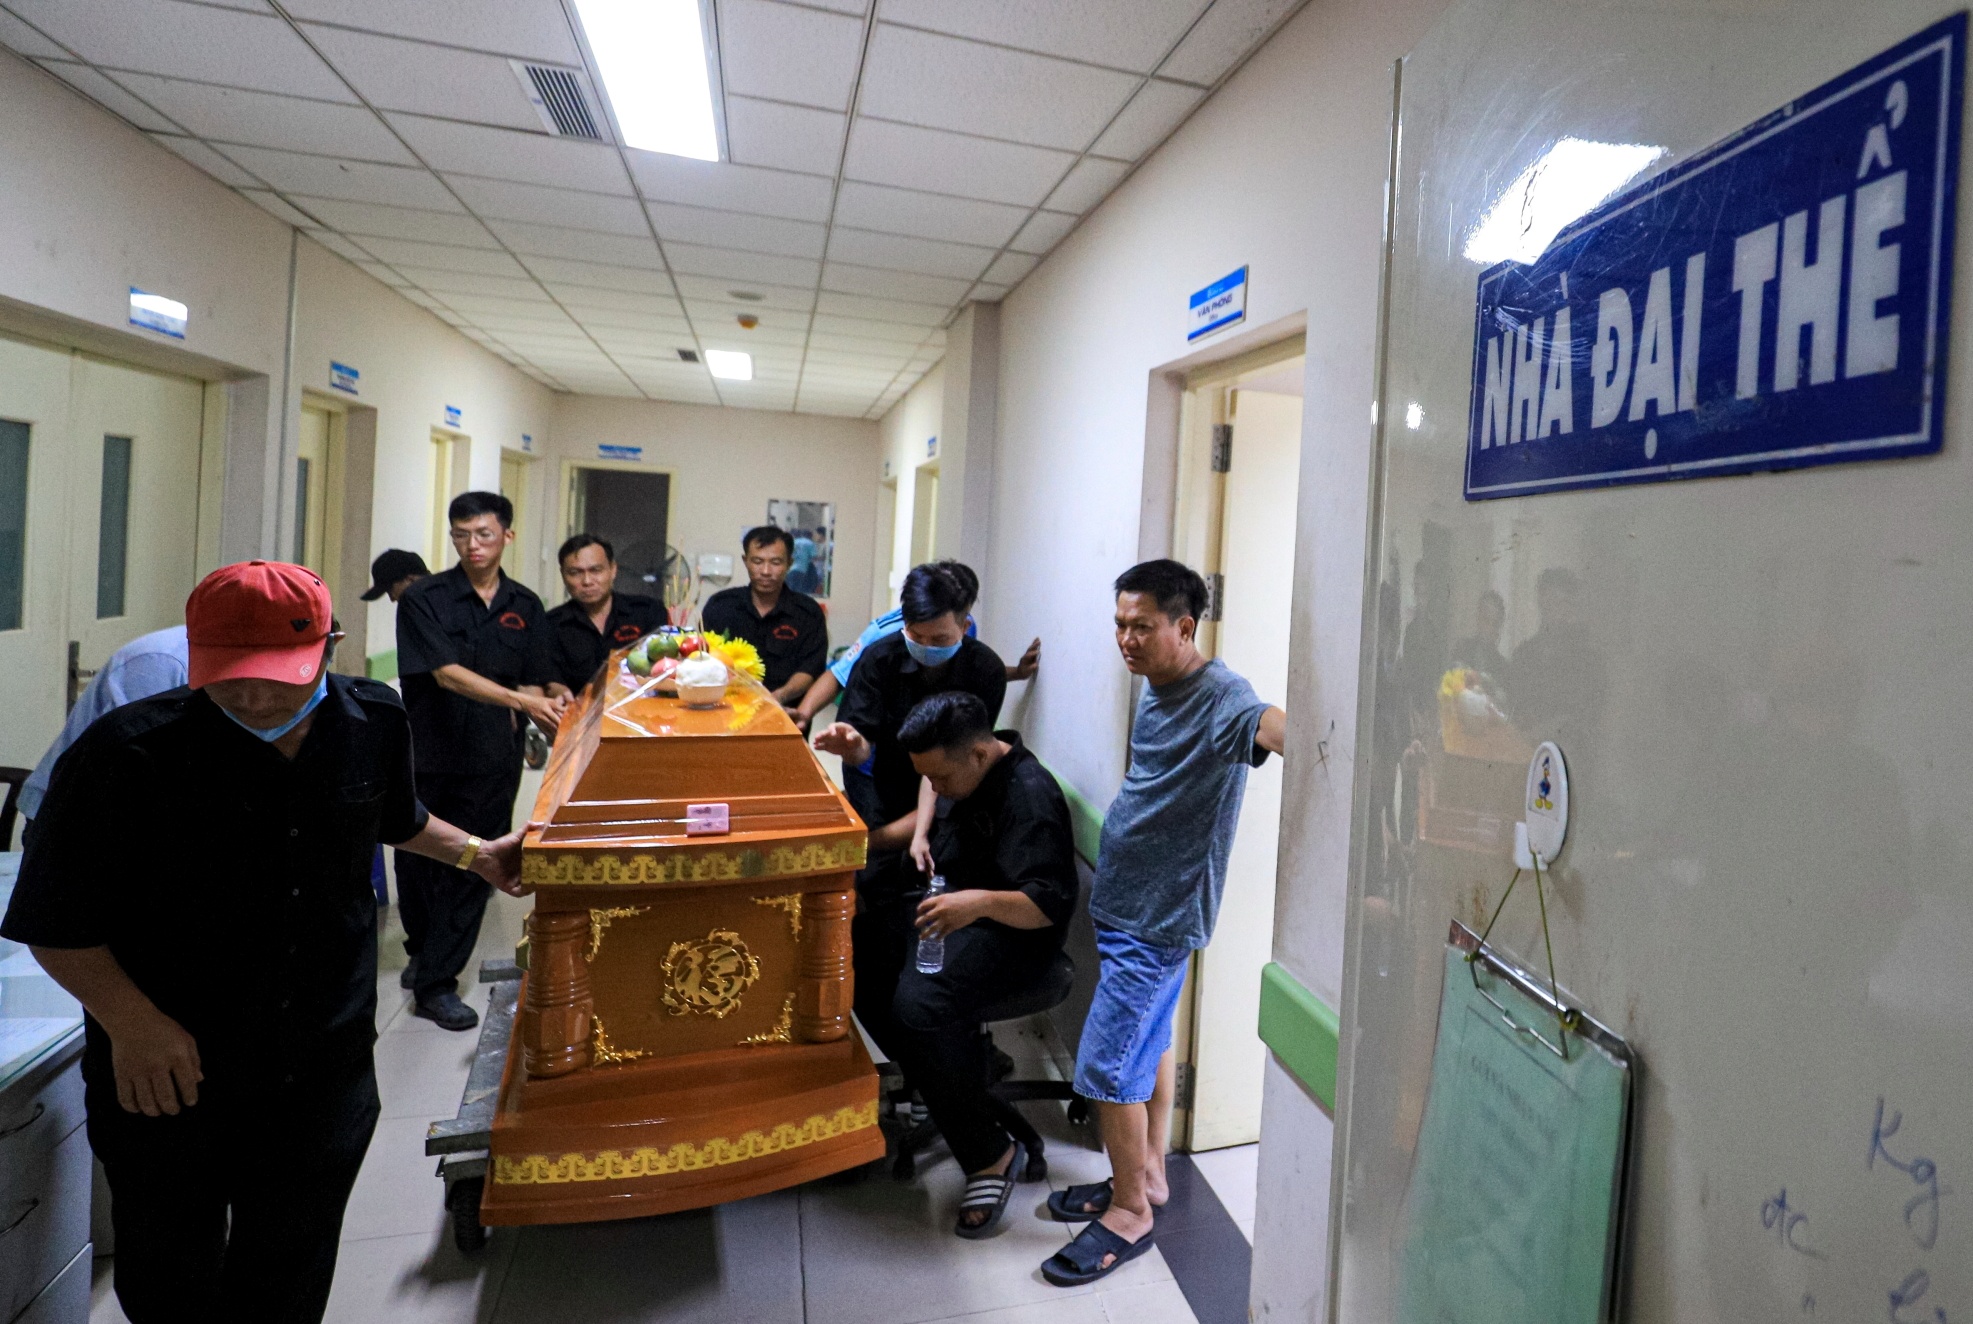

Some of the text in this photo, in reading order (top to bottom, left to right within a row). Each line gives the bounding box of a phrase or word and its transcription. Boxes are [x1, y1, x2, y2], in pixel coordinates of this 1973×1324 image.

[1481, 80, 1908, 459] NHÀ ĐẠI THỂ
